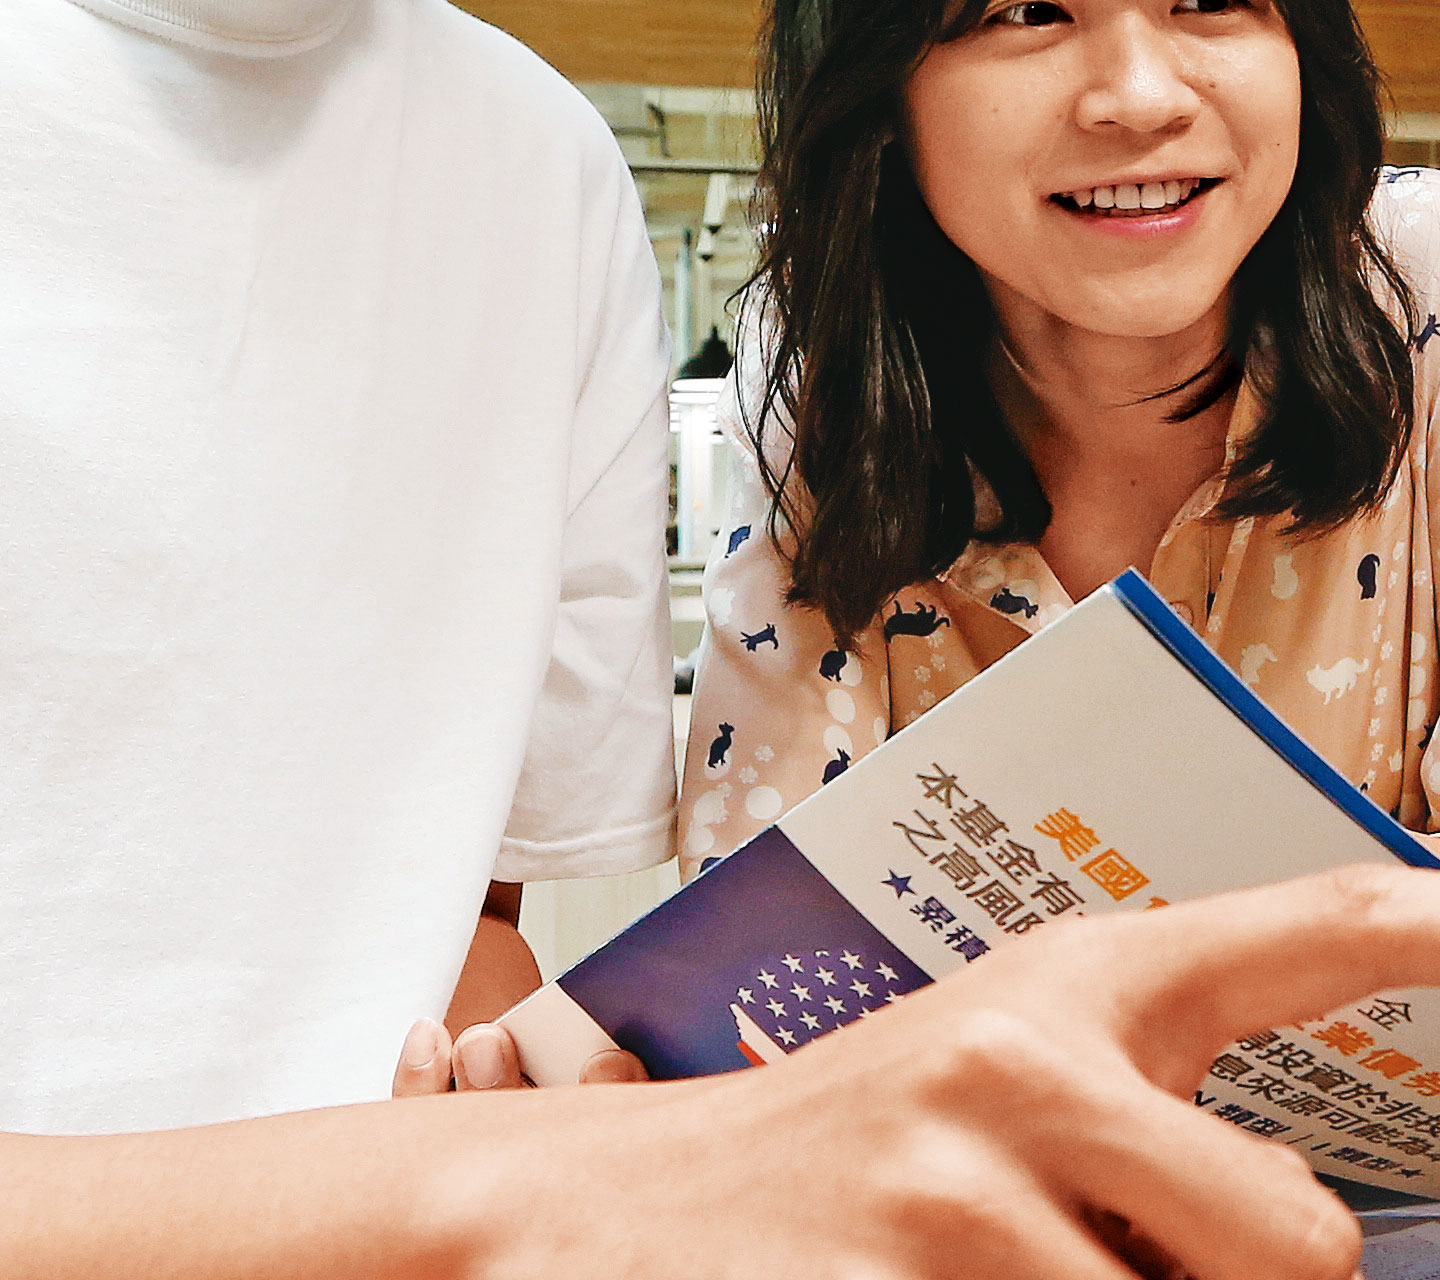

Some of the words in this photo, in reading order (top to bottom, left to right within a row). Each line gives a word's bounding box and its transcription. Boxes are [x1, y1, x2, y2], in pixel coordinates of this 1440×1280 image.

[914, 763, 1089, 927] 本基金有
[1034, 804, 1171, 912] 美國
[908, 895, 993, 963] 累積
[1359, 998, 1412, 1032] 金
